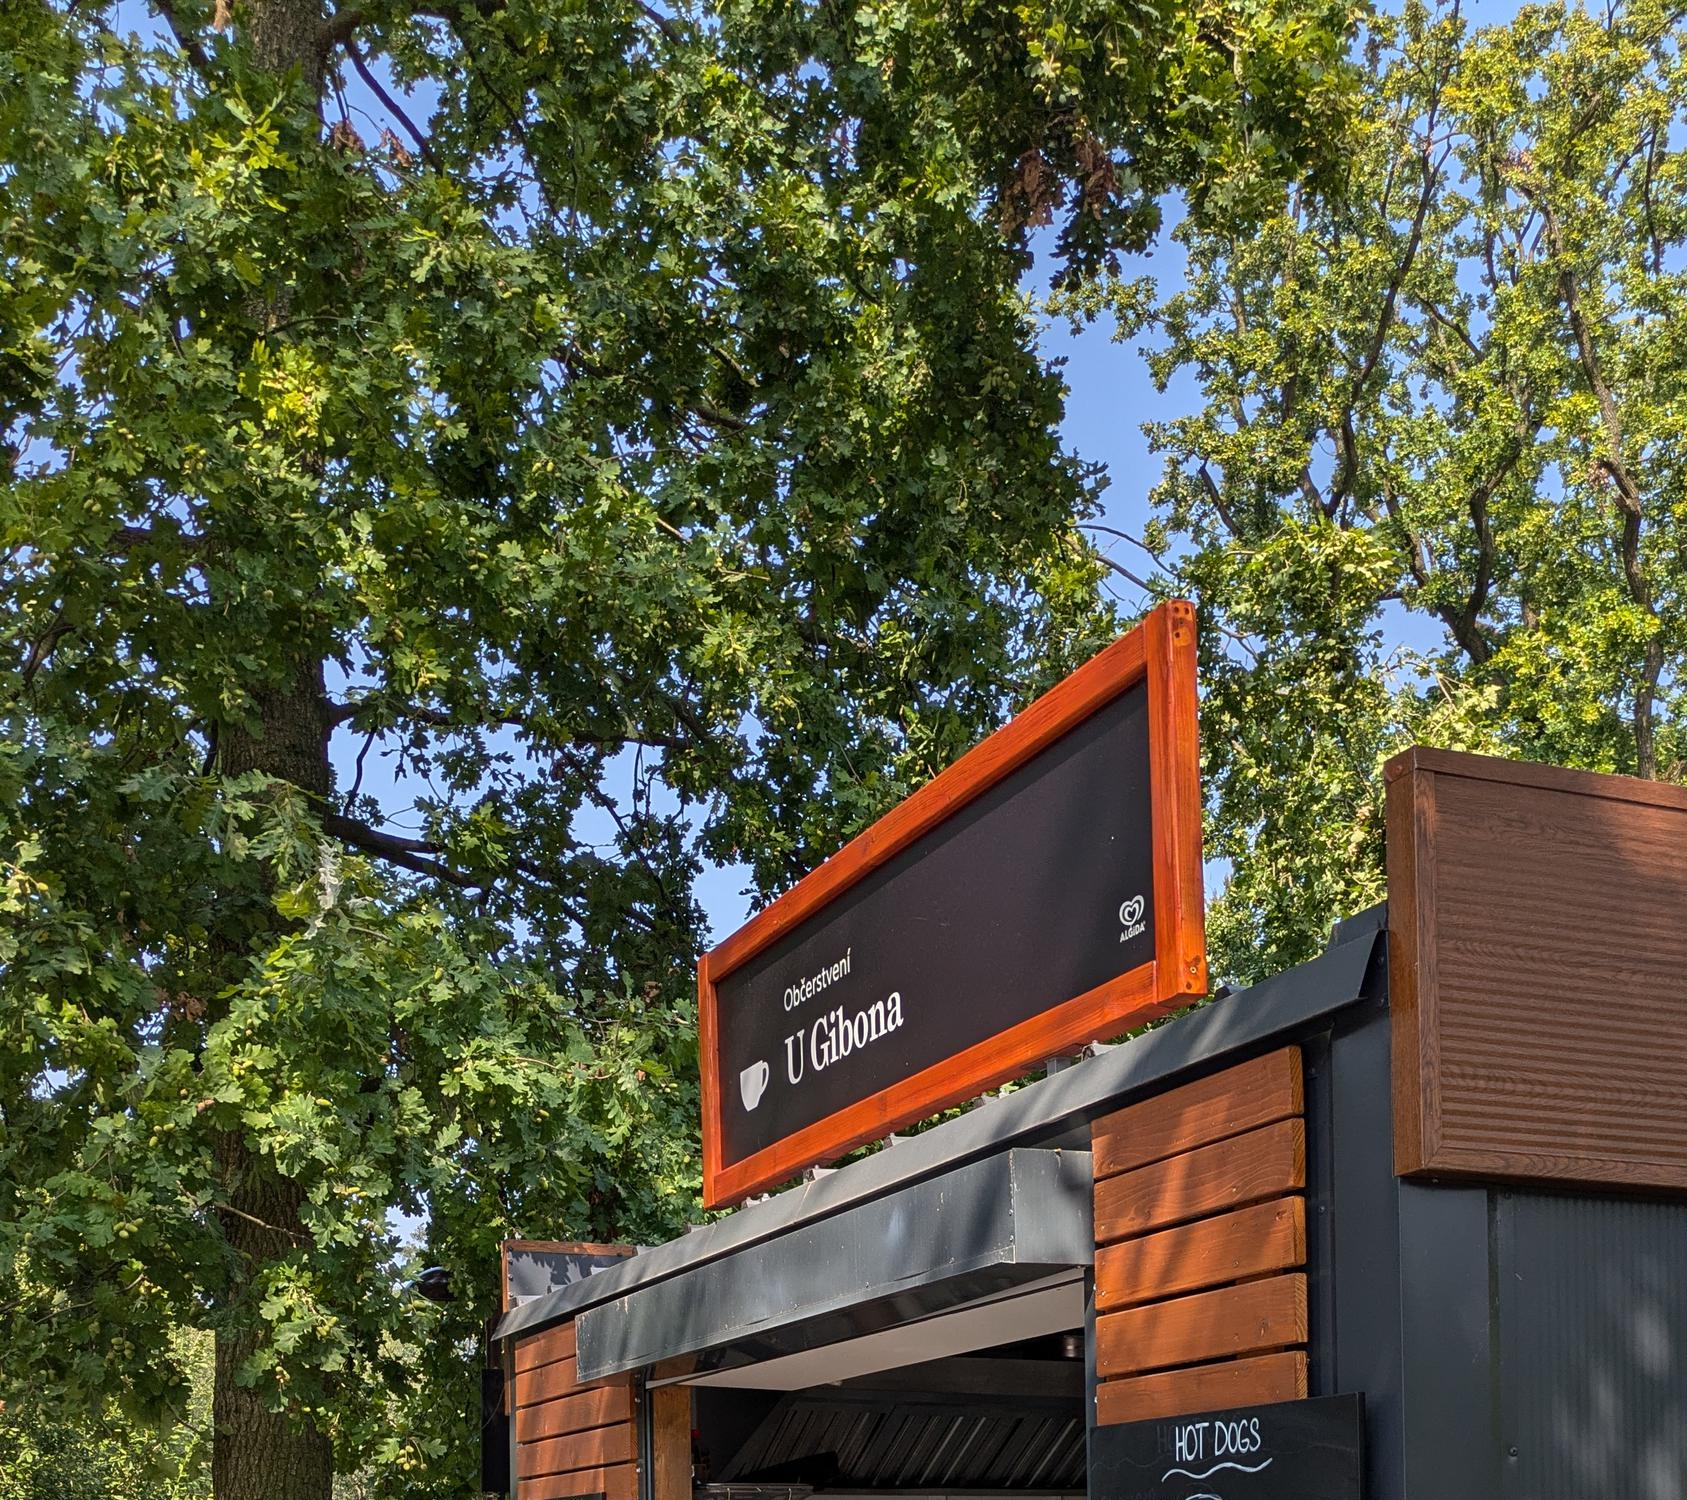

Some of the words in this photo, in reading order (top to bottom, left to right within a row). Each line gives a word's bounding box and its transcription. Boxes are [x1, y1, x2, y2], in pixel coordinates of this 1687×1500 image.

[783, 948, 852, 1012] Občerstvení
[784, 1028, 806, 1086] U
[810, 991, 904, 1071] Gibona
[1175, 1422, 1210, 1462] HOT
[1215, 1417, 1261, 1457] DOGS
